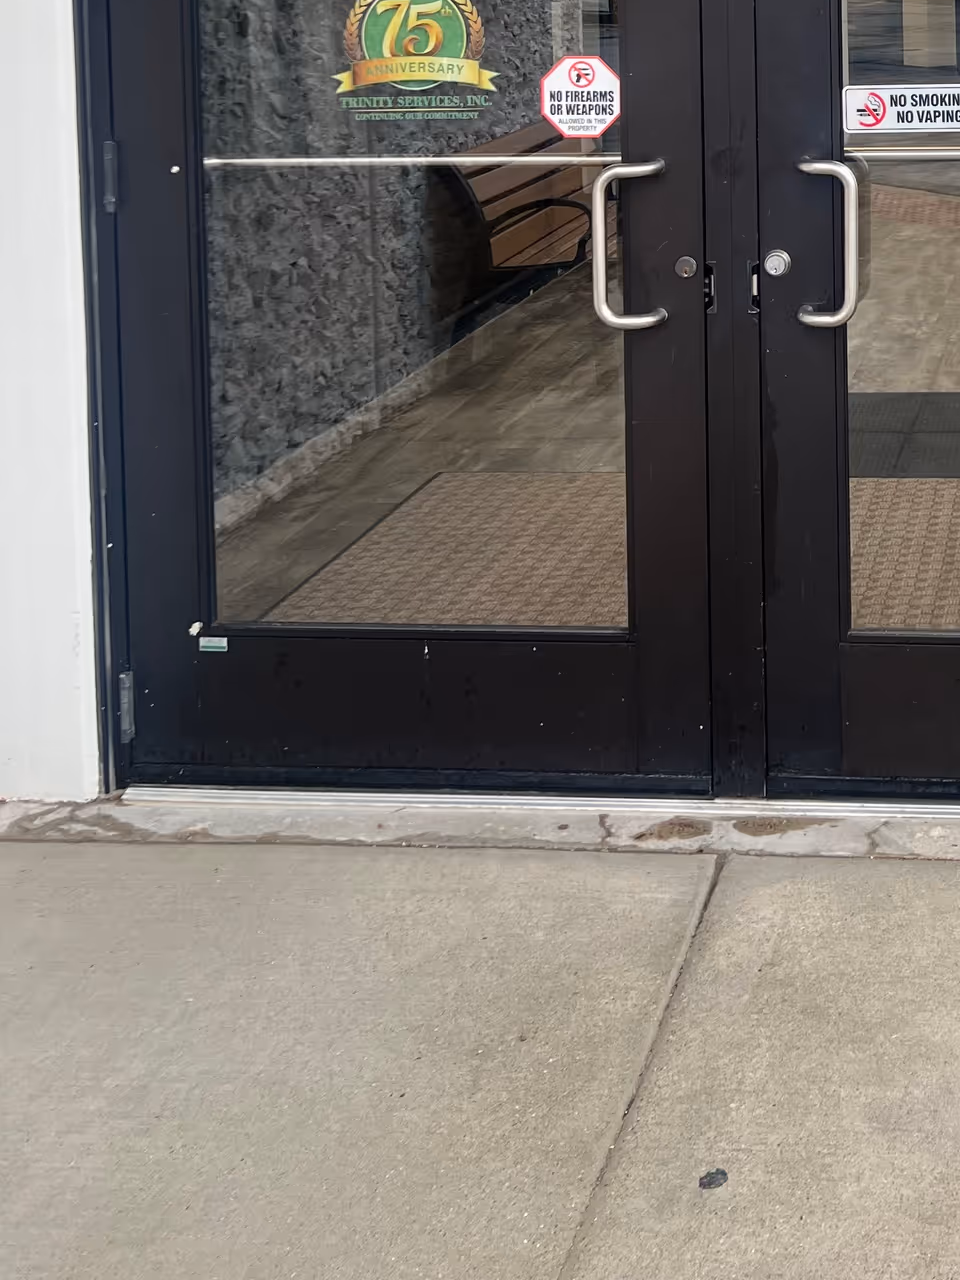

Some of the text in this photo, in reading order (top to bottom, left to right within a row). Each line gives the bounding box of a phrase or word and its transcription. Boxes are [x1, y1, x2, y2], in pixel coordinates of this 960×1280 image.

[366, 62, 465, 76] ANNIVERSARY
[339, 94, 493, 109] TRINITY SERVICES, INC.
[549, 90, 614, 102] NO FIREARMS
[890, 94, 907, 107] NO
[355, 112, 404, 120] CONTINUING
[424, 111, 479, 120] COMMITMENT
[549, 104, 614, 115] OR WEAPONS
[897, 110, 914, 123] NO
